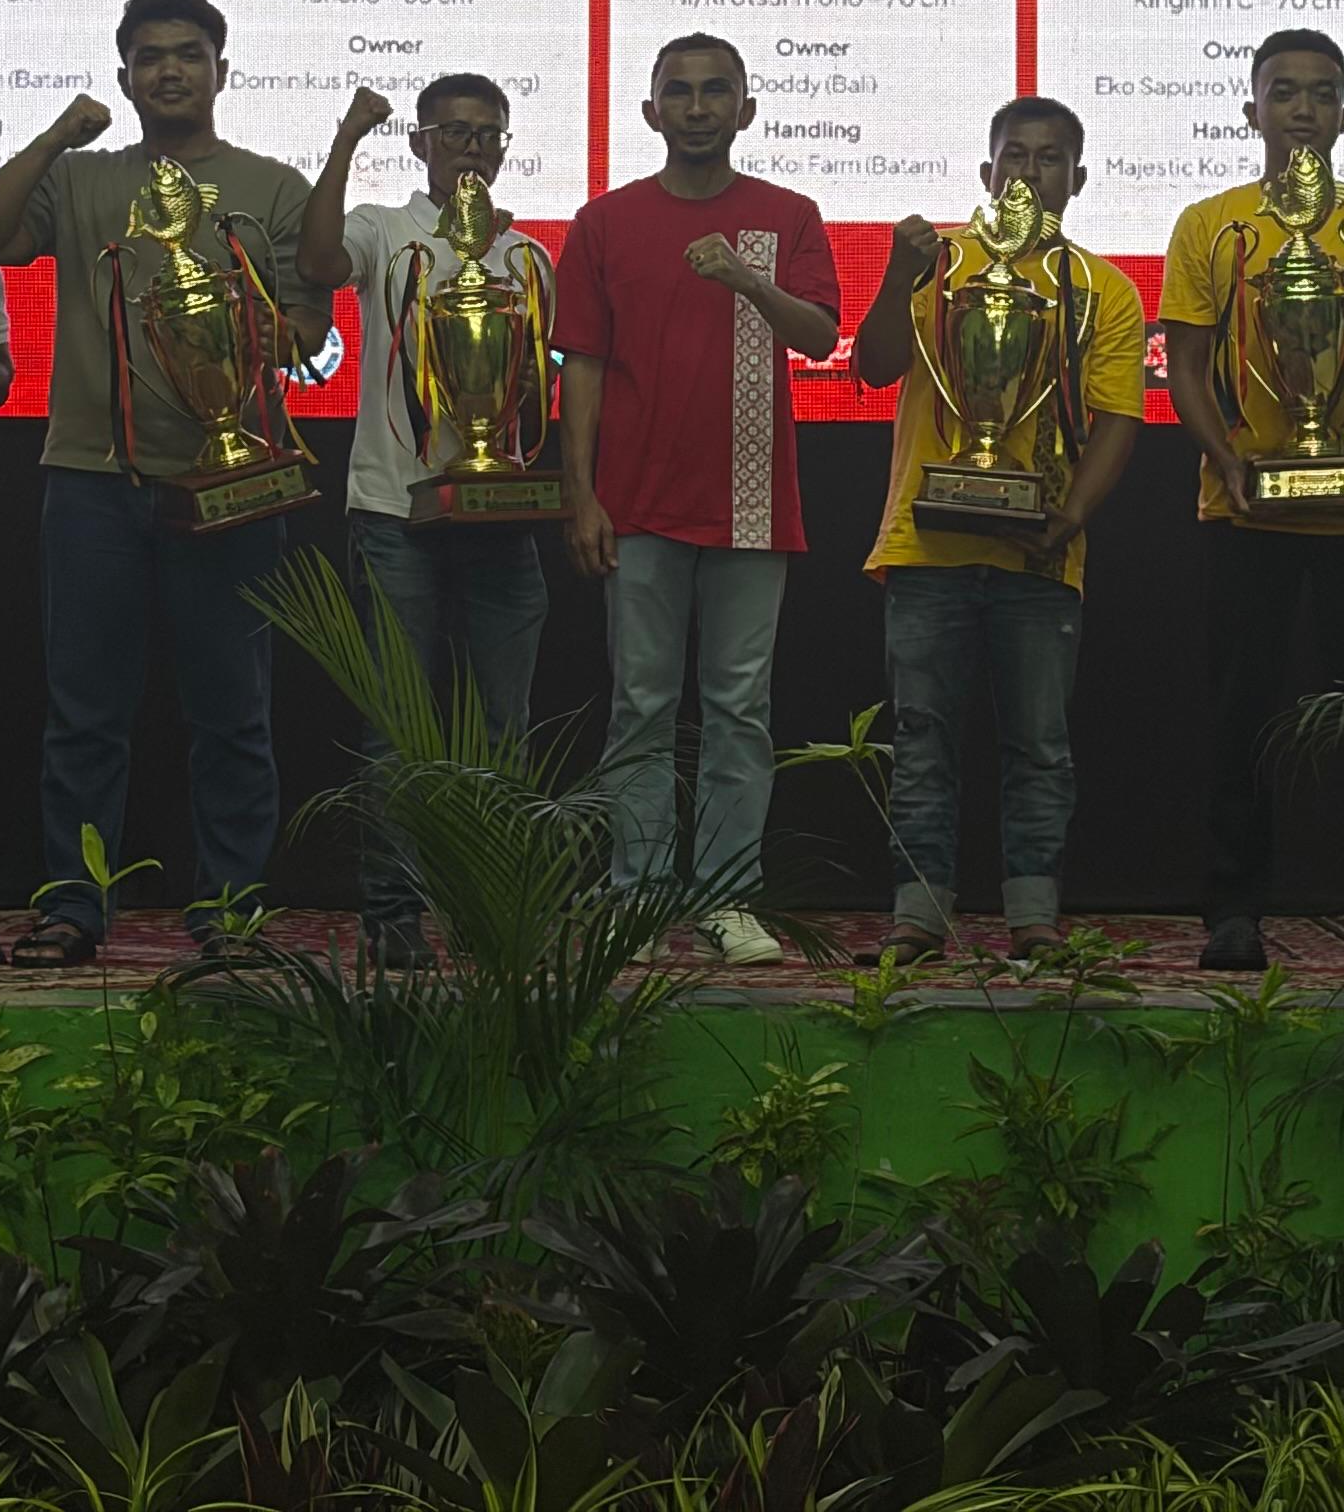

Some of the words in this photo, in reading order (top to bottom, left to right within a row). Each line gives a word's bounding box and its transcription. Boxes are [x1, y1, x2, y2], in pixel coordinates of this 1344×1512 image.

[349, 36, 423, 55] Owner
[776, 38, 851, 56] Owner
[1203, 40, 1256, 59] Own
[8, 69, 93, 90] (Batam)
[750, 74, 820, 99] Doddy
[1095, 76, 1135, 95] Eko
[1140, 76, 1226, 98] Saputro
[764, 121, 861, 143] Handling
[809, 155, 861, 174] Farm
[866, 155, 947, 177] (Batam)
[1106, 157, 1193, 180] Majestic
